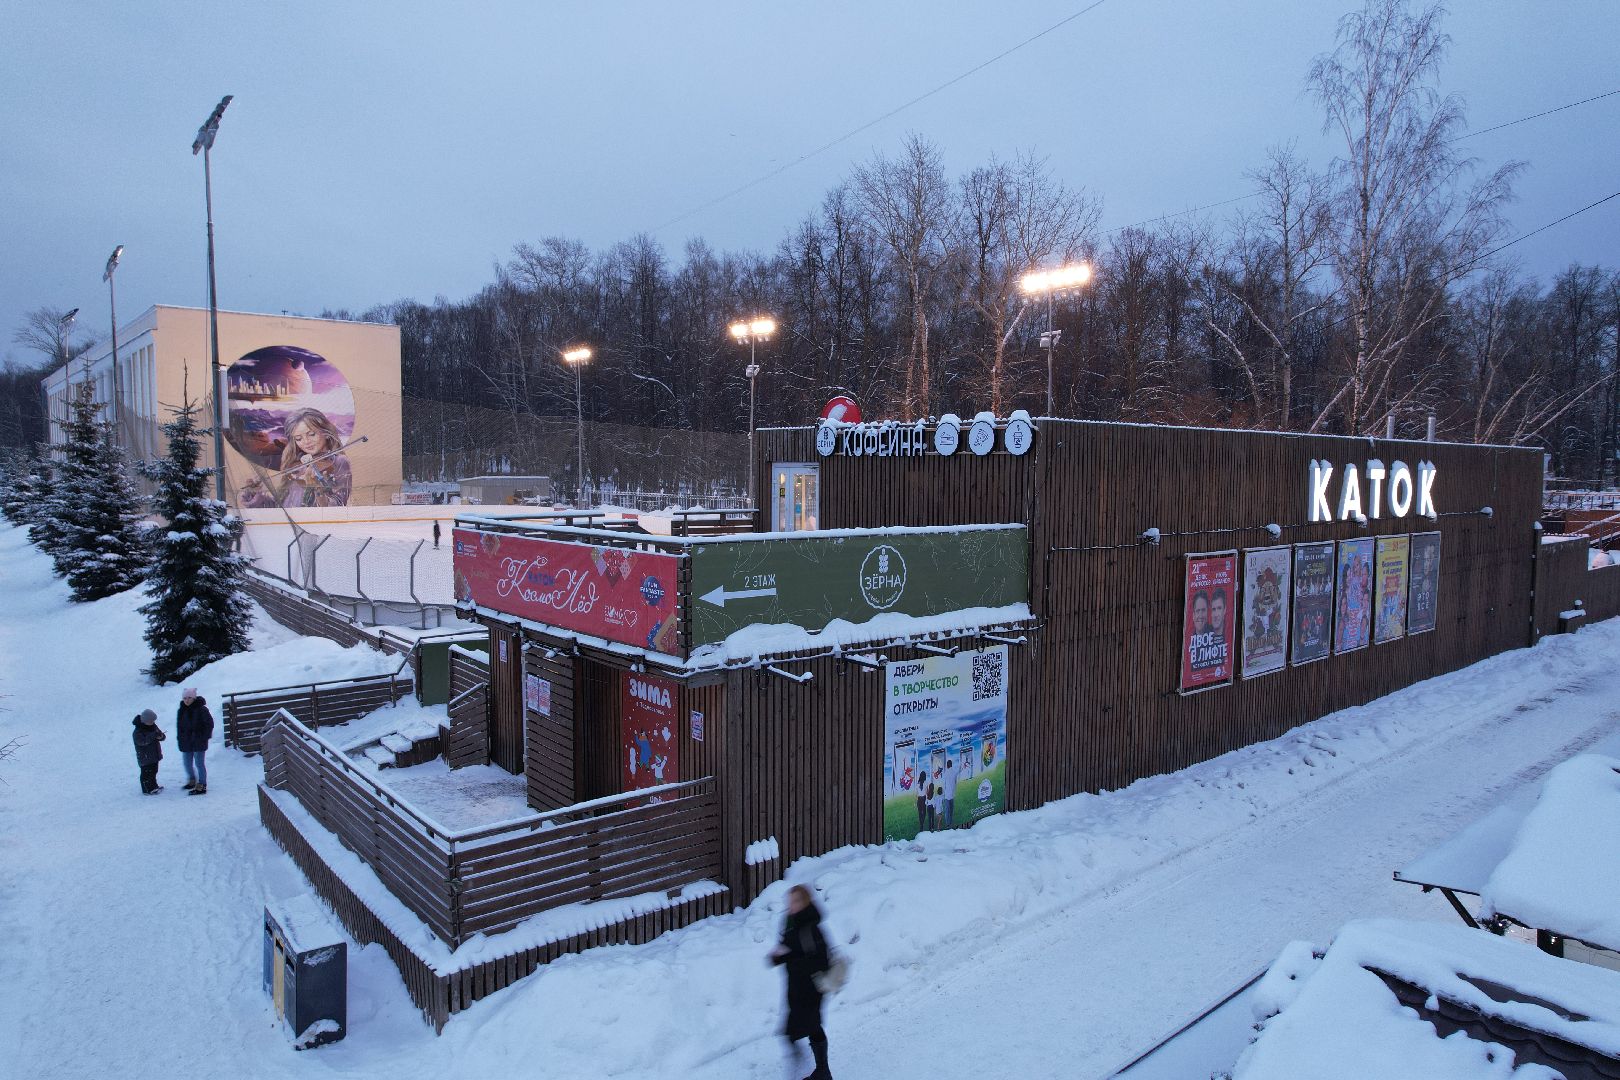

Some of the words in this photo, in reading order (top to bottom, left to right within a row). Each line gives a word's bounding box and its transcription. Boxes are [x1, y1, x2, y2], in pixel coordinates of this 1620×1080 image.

[1308, 464, 1437, 522] КАТОК
[744, 575, 750, 588] 2
[752, 573, 776, 588] ЭТАЖ
[864, 573, 902, 590] ЗЁРНА
[1189, 631, 1215, 653] ДВОЕ
[1191, 647, 1198, 664] В
[1198, 642, 1228, 661] ЛИФТЕ
[893, 663, 925, 678] ДВЕРИ
[629, 678, 672, 709] ЗИМА
[893, 685, 900, 697] В
[901, 675, 959, 696] ТВОРЧЕСТВО
[893, 696, 939, 716] ОТКРЫТЫ
